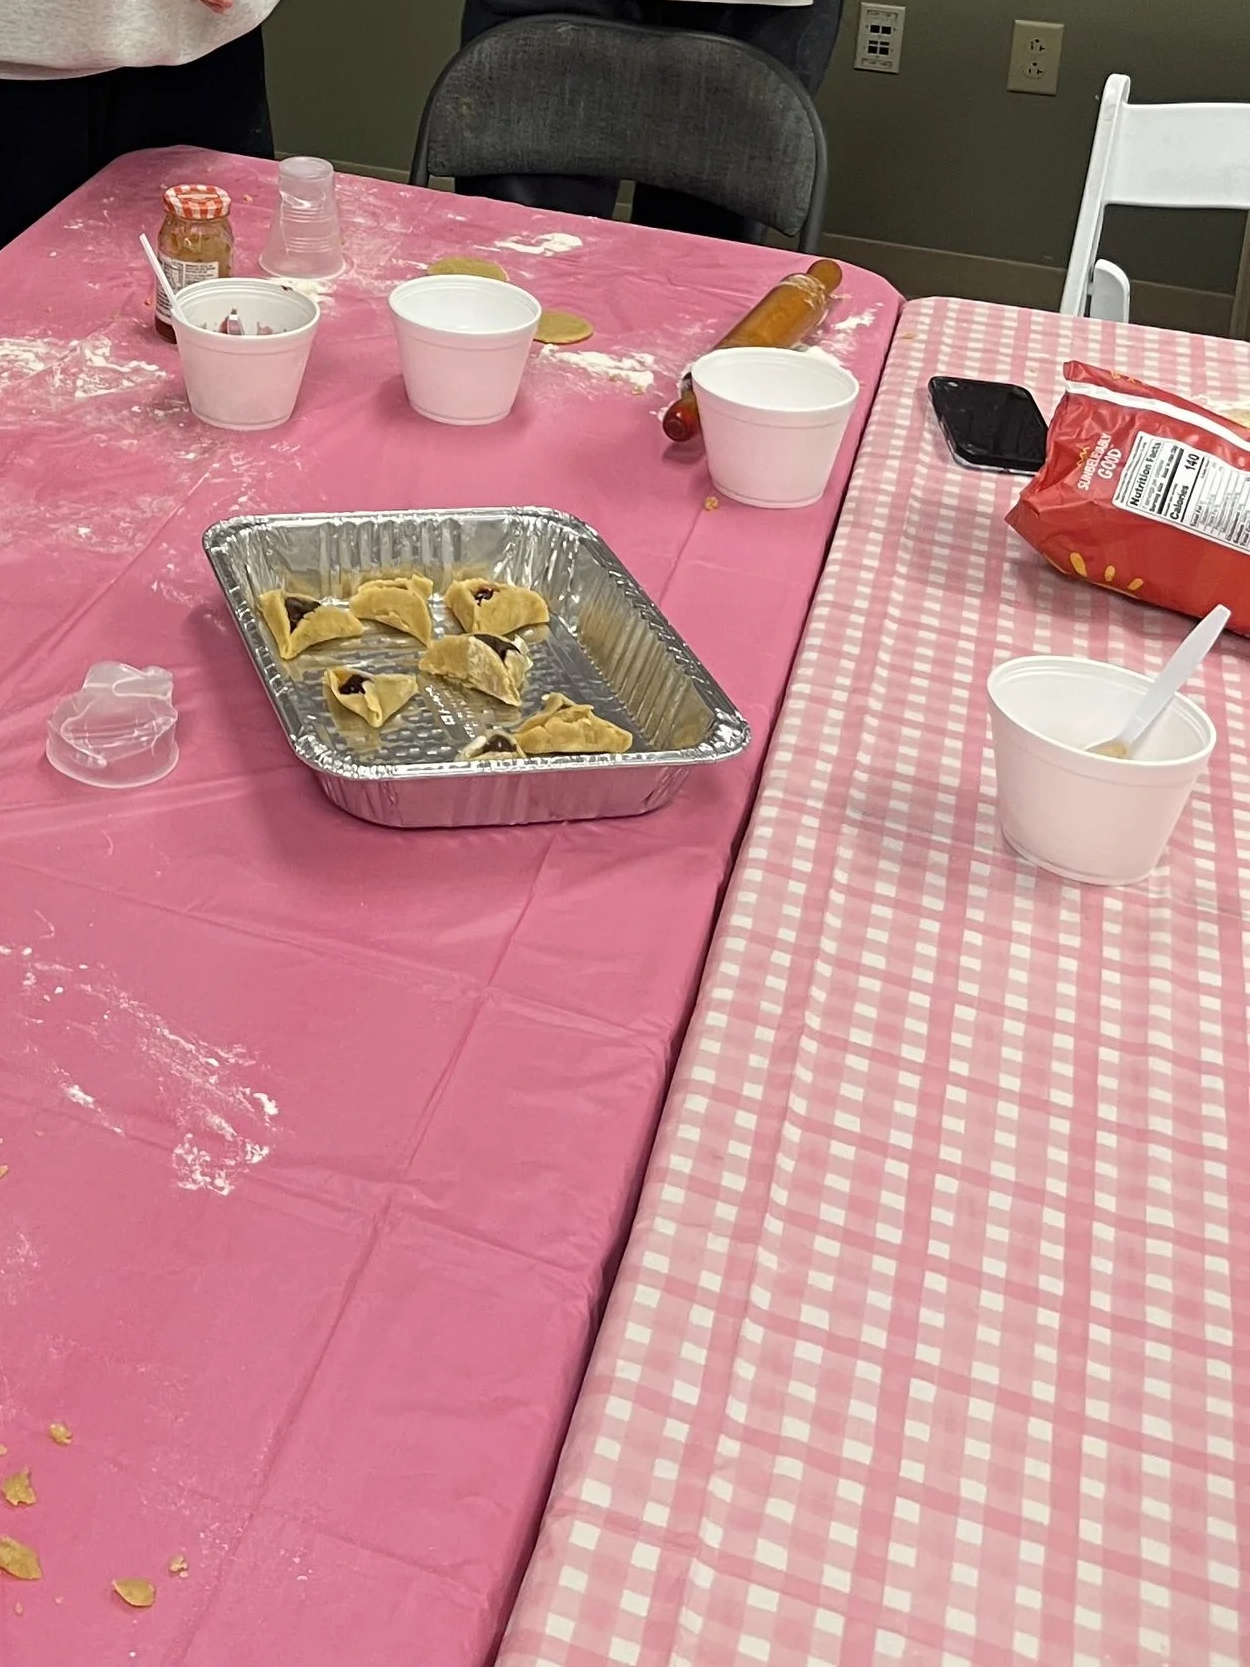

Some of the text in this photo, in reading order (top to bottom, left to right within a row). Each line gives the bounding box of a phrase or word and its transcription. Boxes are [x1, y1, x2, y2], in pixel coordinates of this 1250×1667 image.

[1098, 448, 1122, 479] GOOD
[1129, 463, 1152, 507] Nutrition
[1146, 442, 1162, 463] Facts
[1170, 485, 1190, 520] Calories
[1184, 453, 1200, 471] 140
